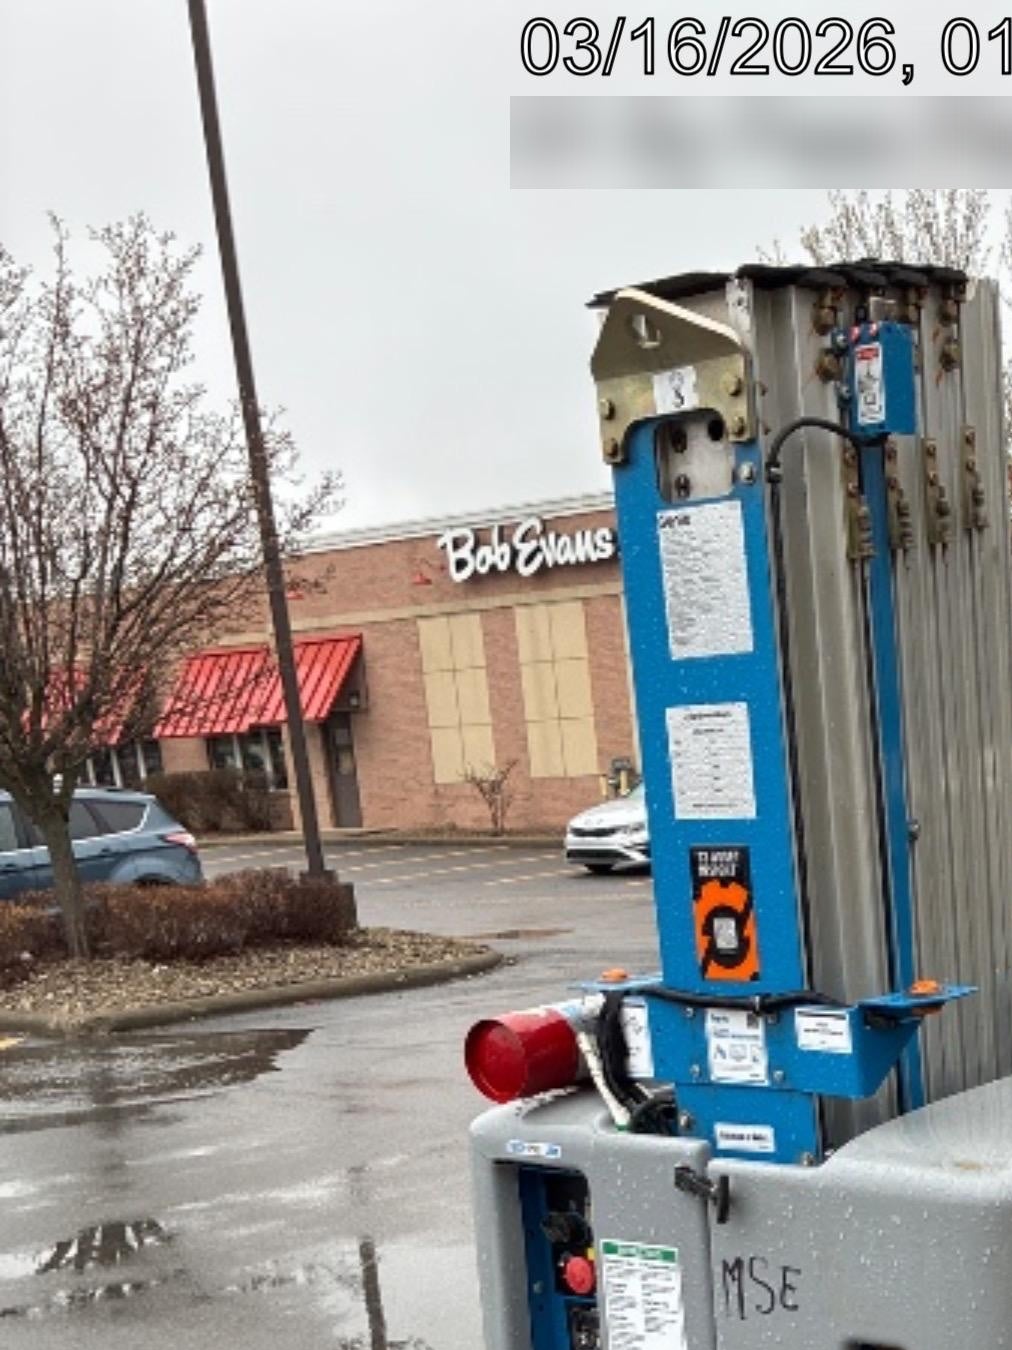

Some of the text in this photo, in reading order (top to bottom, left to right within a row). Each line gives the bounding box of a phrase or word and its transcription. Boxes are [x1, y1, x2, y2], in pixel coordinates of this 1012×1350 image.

[437, 517, 616, 583] Bob Evans
[721, 1256, 802, 1320] MSE
